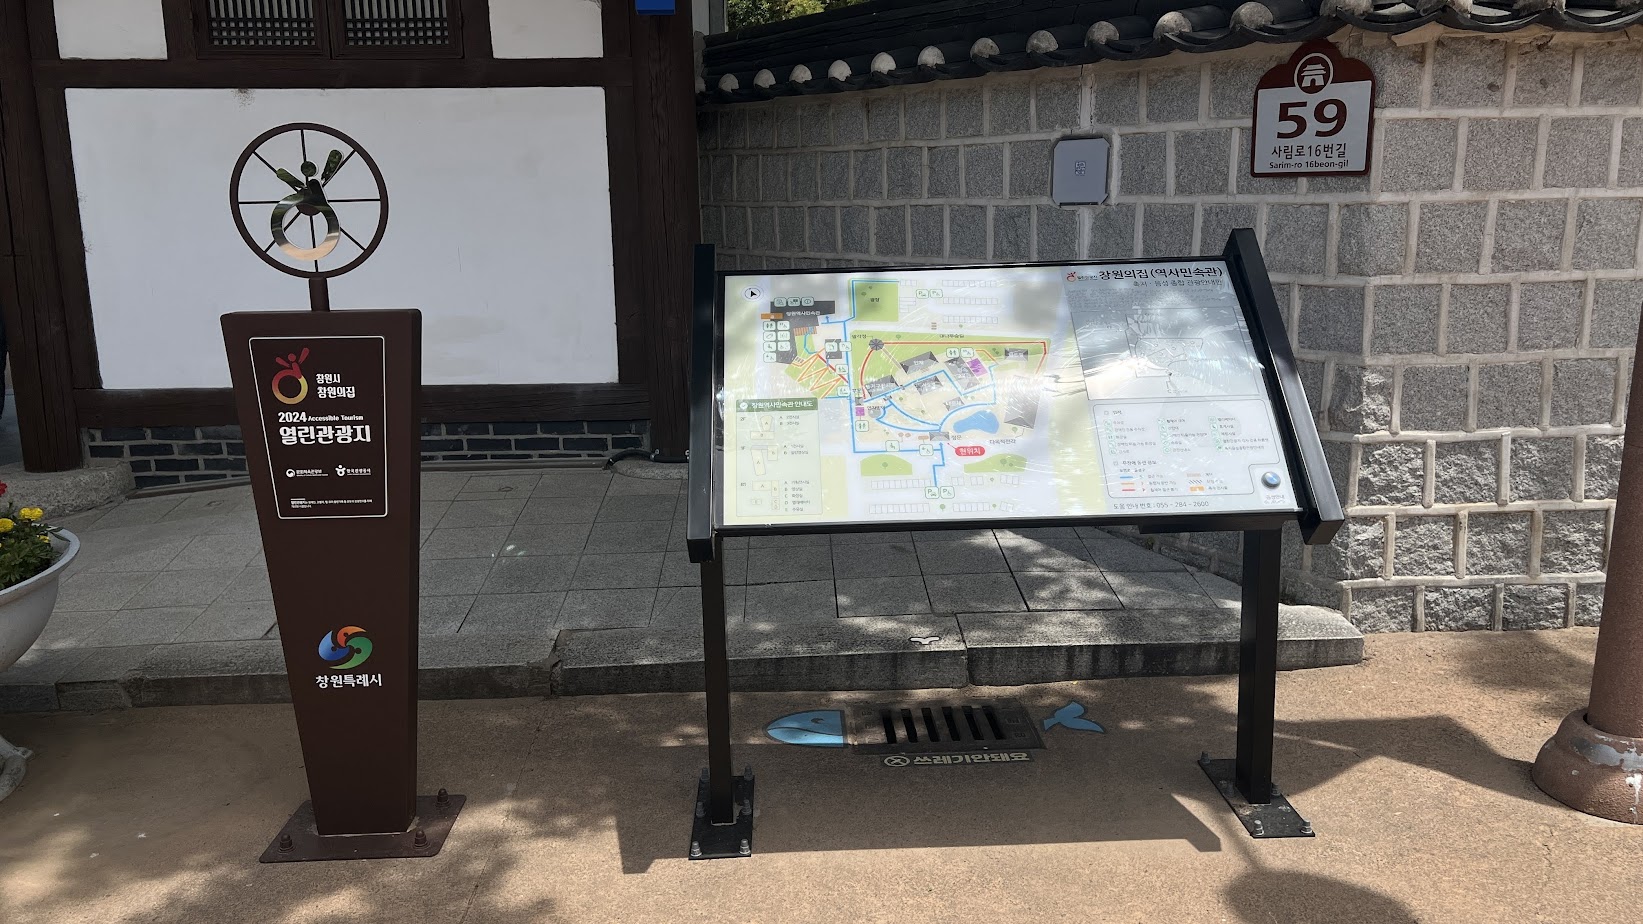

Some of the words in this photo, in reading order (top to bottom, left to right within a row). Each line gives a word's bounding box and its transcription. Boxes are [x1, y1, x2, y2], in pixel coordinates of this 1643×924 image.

[1277, 98, 1348, 139] 59
[1271, 142, 1347, 160] 사림로16번길
[1269, 161, 1303, 169] Sarim-ro
[1305, 159, 1349, 169] 16beon-gil
[316, 373, 341, 384] 창원시
[317, 386, 356, 399] 창원의집
[277, 411, 307, 423] 2024
[308, 414, 340, 422] Accessible
[279, 424, 372, 446] 열린관광지
[959, 447, 981, 455] 현위치
[315, 673, 383, 689] 창원특례시
[913, 752, 1030, 765] 쓰레기안돼요
